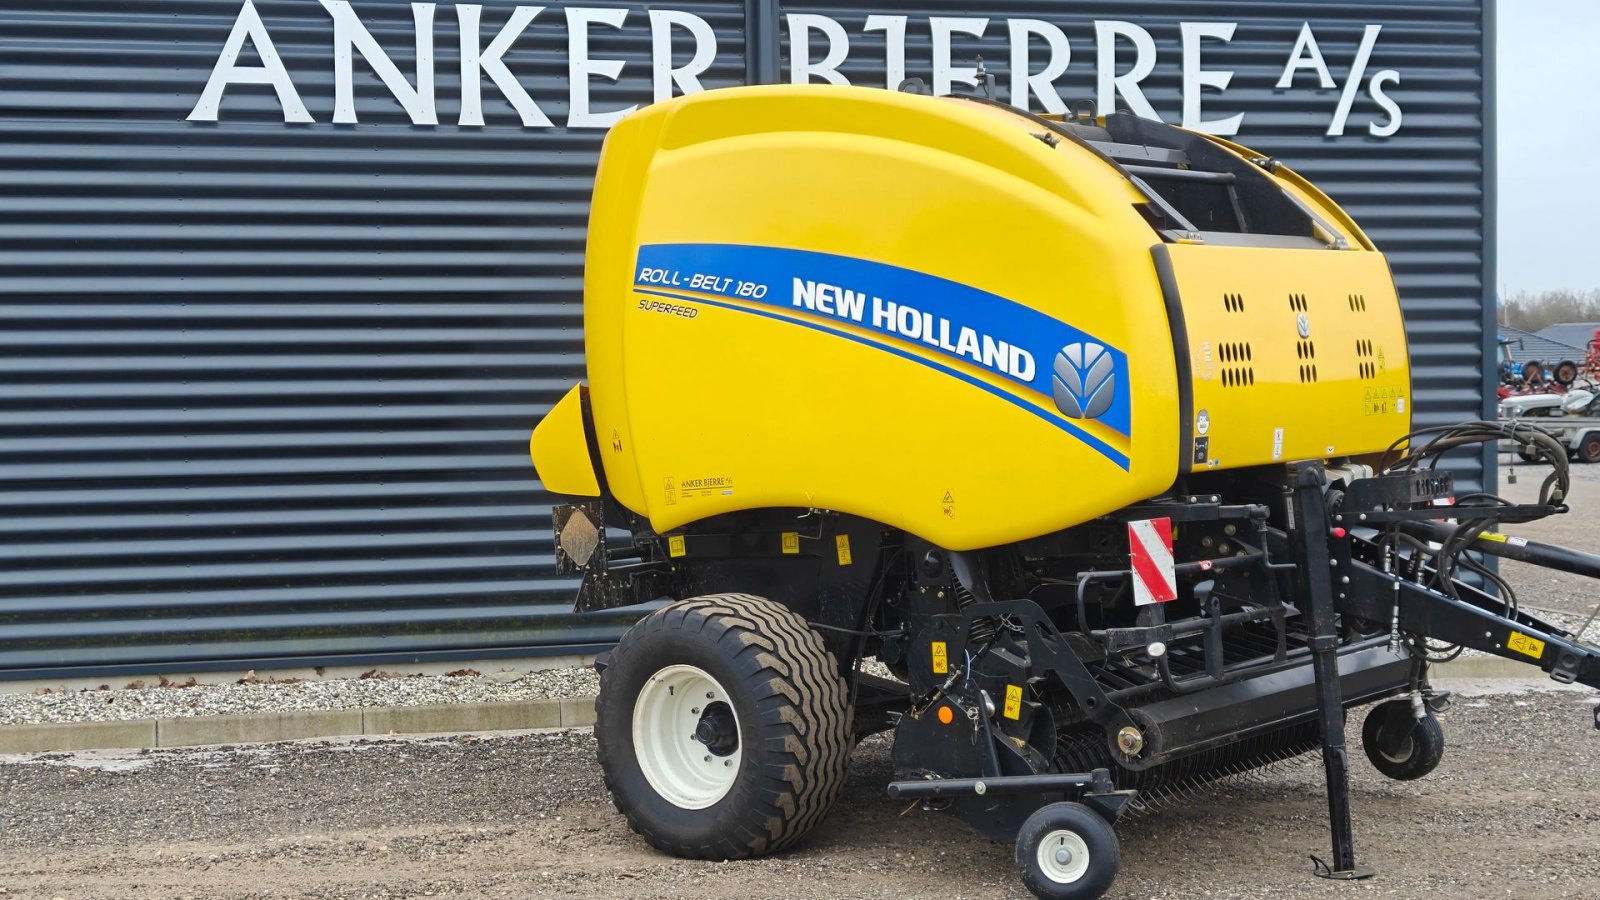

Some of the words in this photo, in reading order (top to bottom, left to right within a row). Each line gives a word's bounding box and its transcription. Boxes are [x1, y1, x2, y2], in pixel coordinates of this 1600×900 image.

[187, 0, 717, 127] ANKER
[786, 13, 1245, 136] BJERRE
[1276, 20, 1400, 137] A/S
[638, 268, 733, 293] ROLL-BELT
[735, 281, 768, 299] 180
[638, 300, 698, 318] SUPERFEED
[793, 277, 865, 322] NEW
[873, 297, 1036, 382] HOLLAND
[681, 479, 703, 488] ANKER
[703, 477, 725, 488] BJERRE
